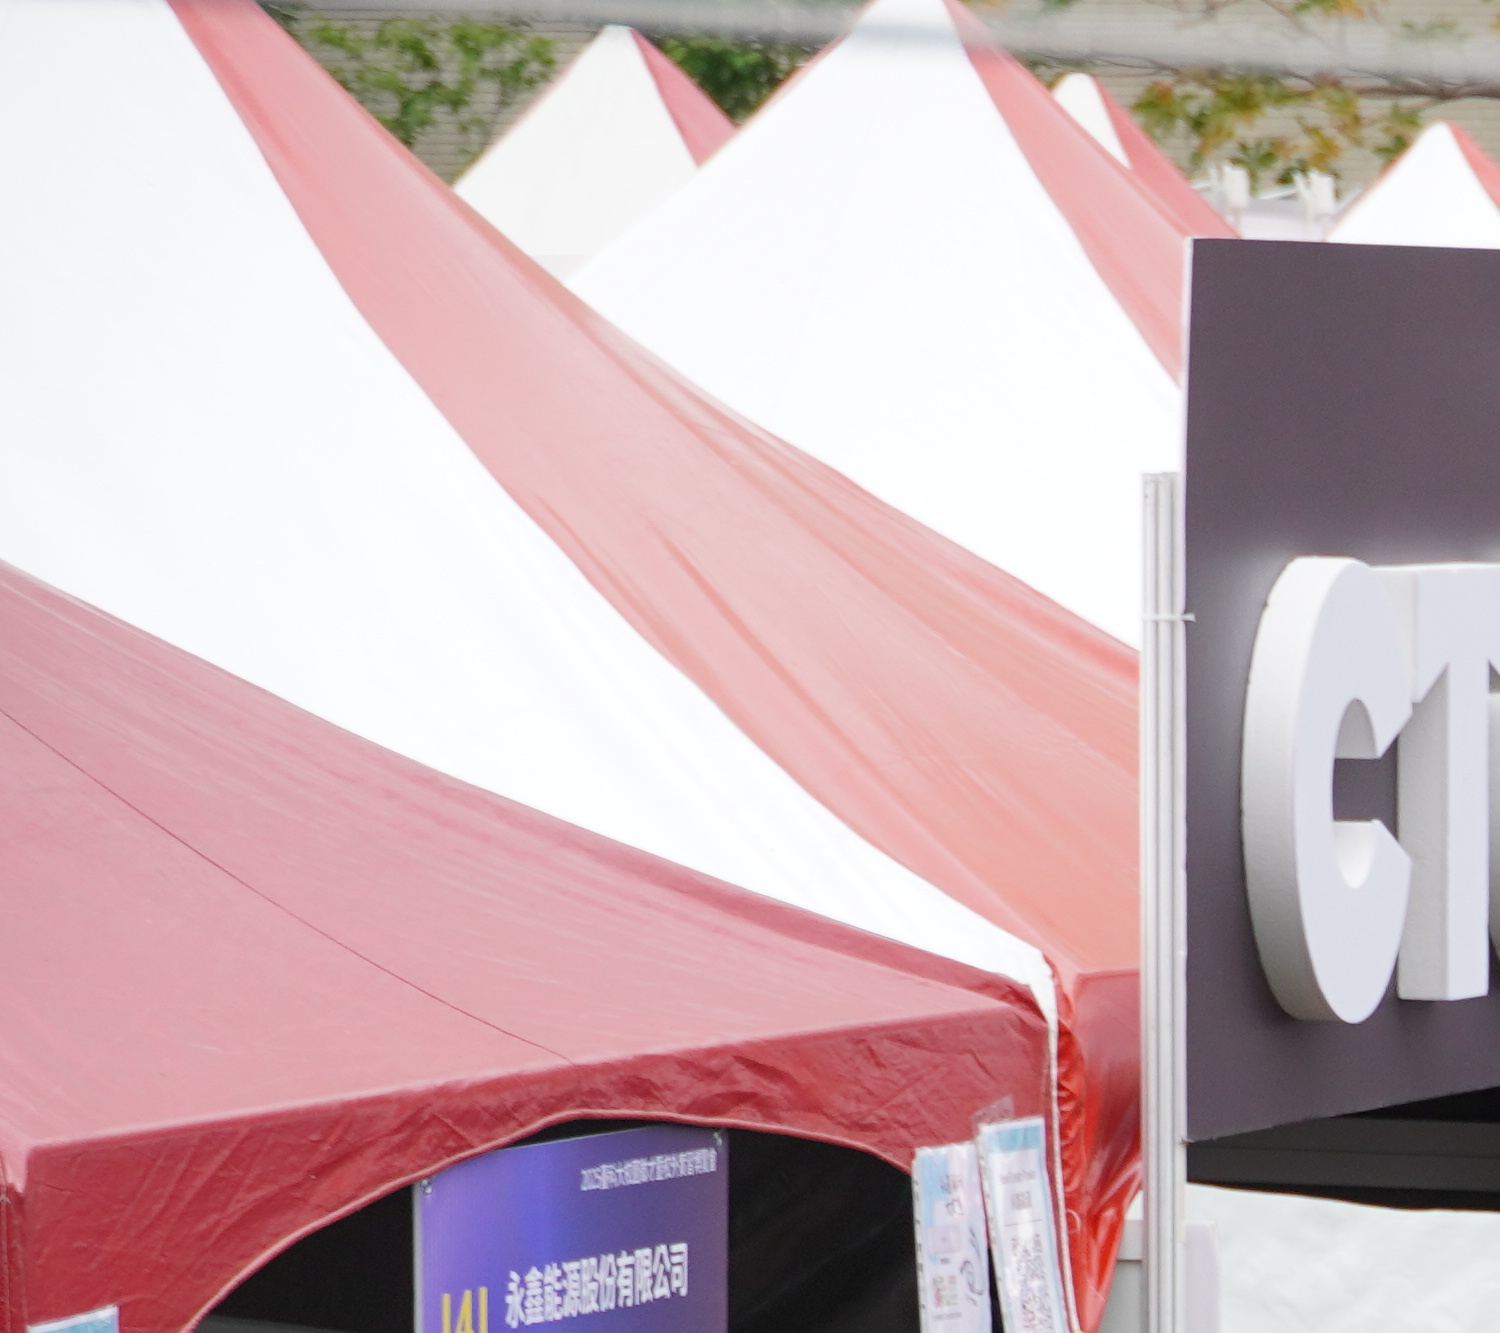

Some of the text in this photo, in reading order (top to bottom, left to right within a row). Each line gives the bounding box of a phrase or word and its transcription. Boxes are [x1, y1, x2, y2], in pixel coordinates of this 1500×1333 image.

[504, 1243, 689, 1330] 永鑫能源股份有限公司
